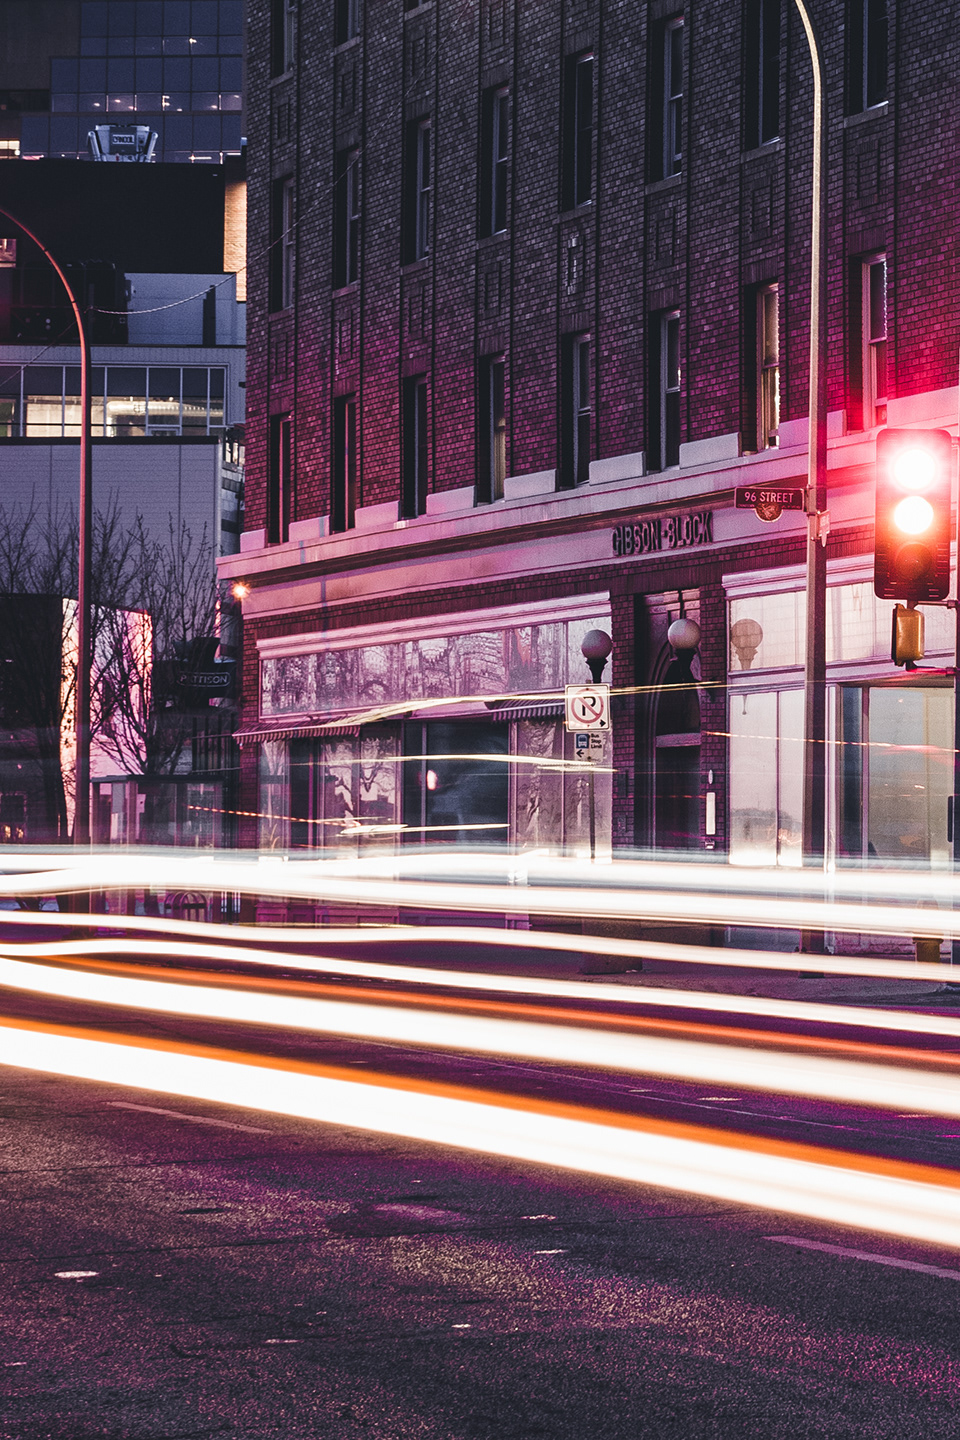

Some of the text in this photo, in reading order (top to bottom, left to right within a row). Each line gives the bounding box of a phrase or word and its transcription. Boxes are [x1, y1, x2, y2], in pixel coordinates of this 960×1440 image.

[744, 491, 794, 503] 96 STREET
[180, 675, 228, 683] PTTISON
